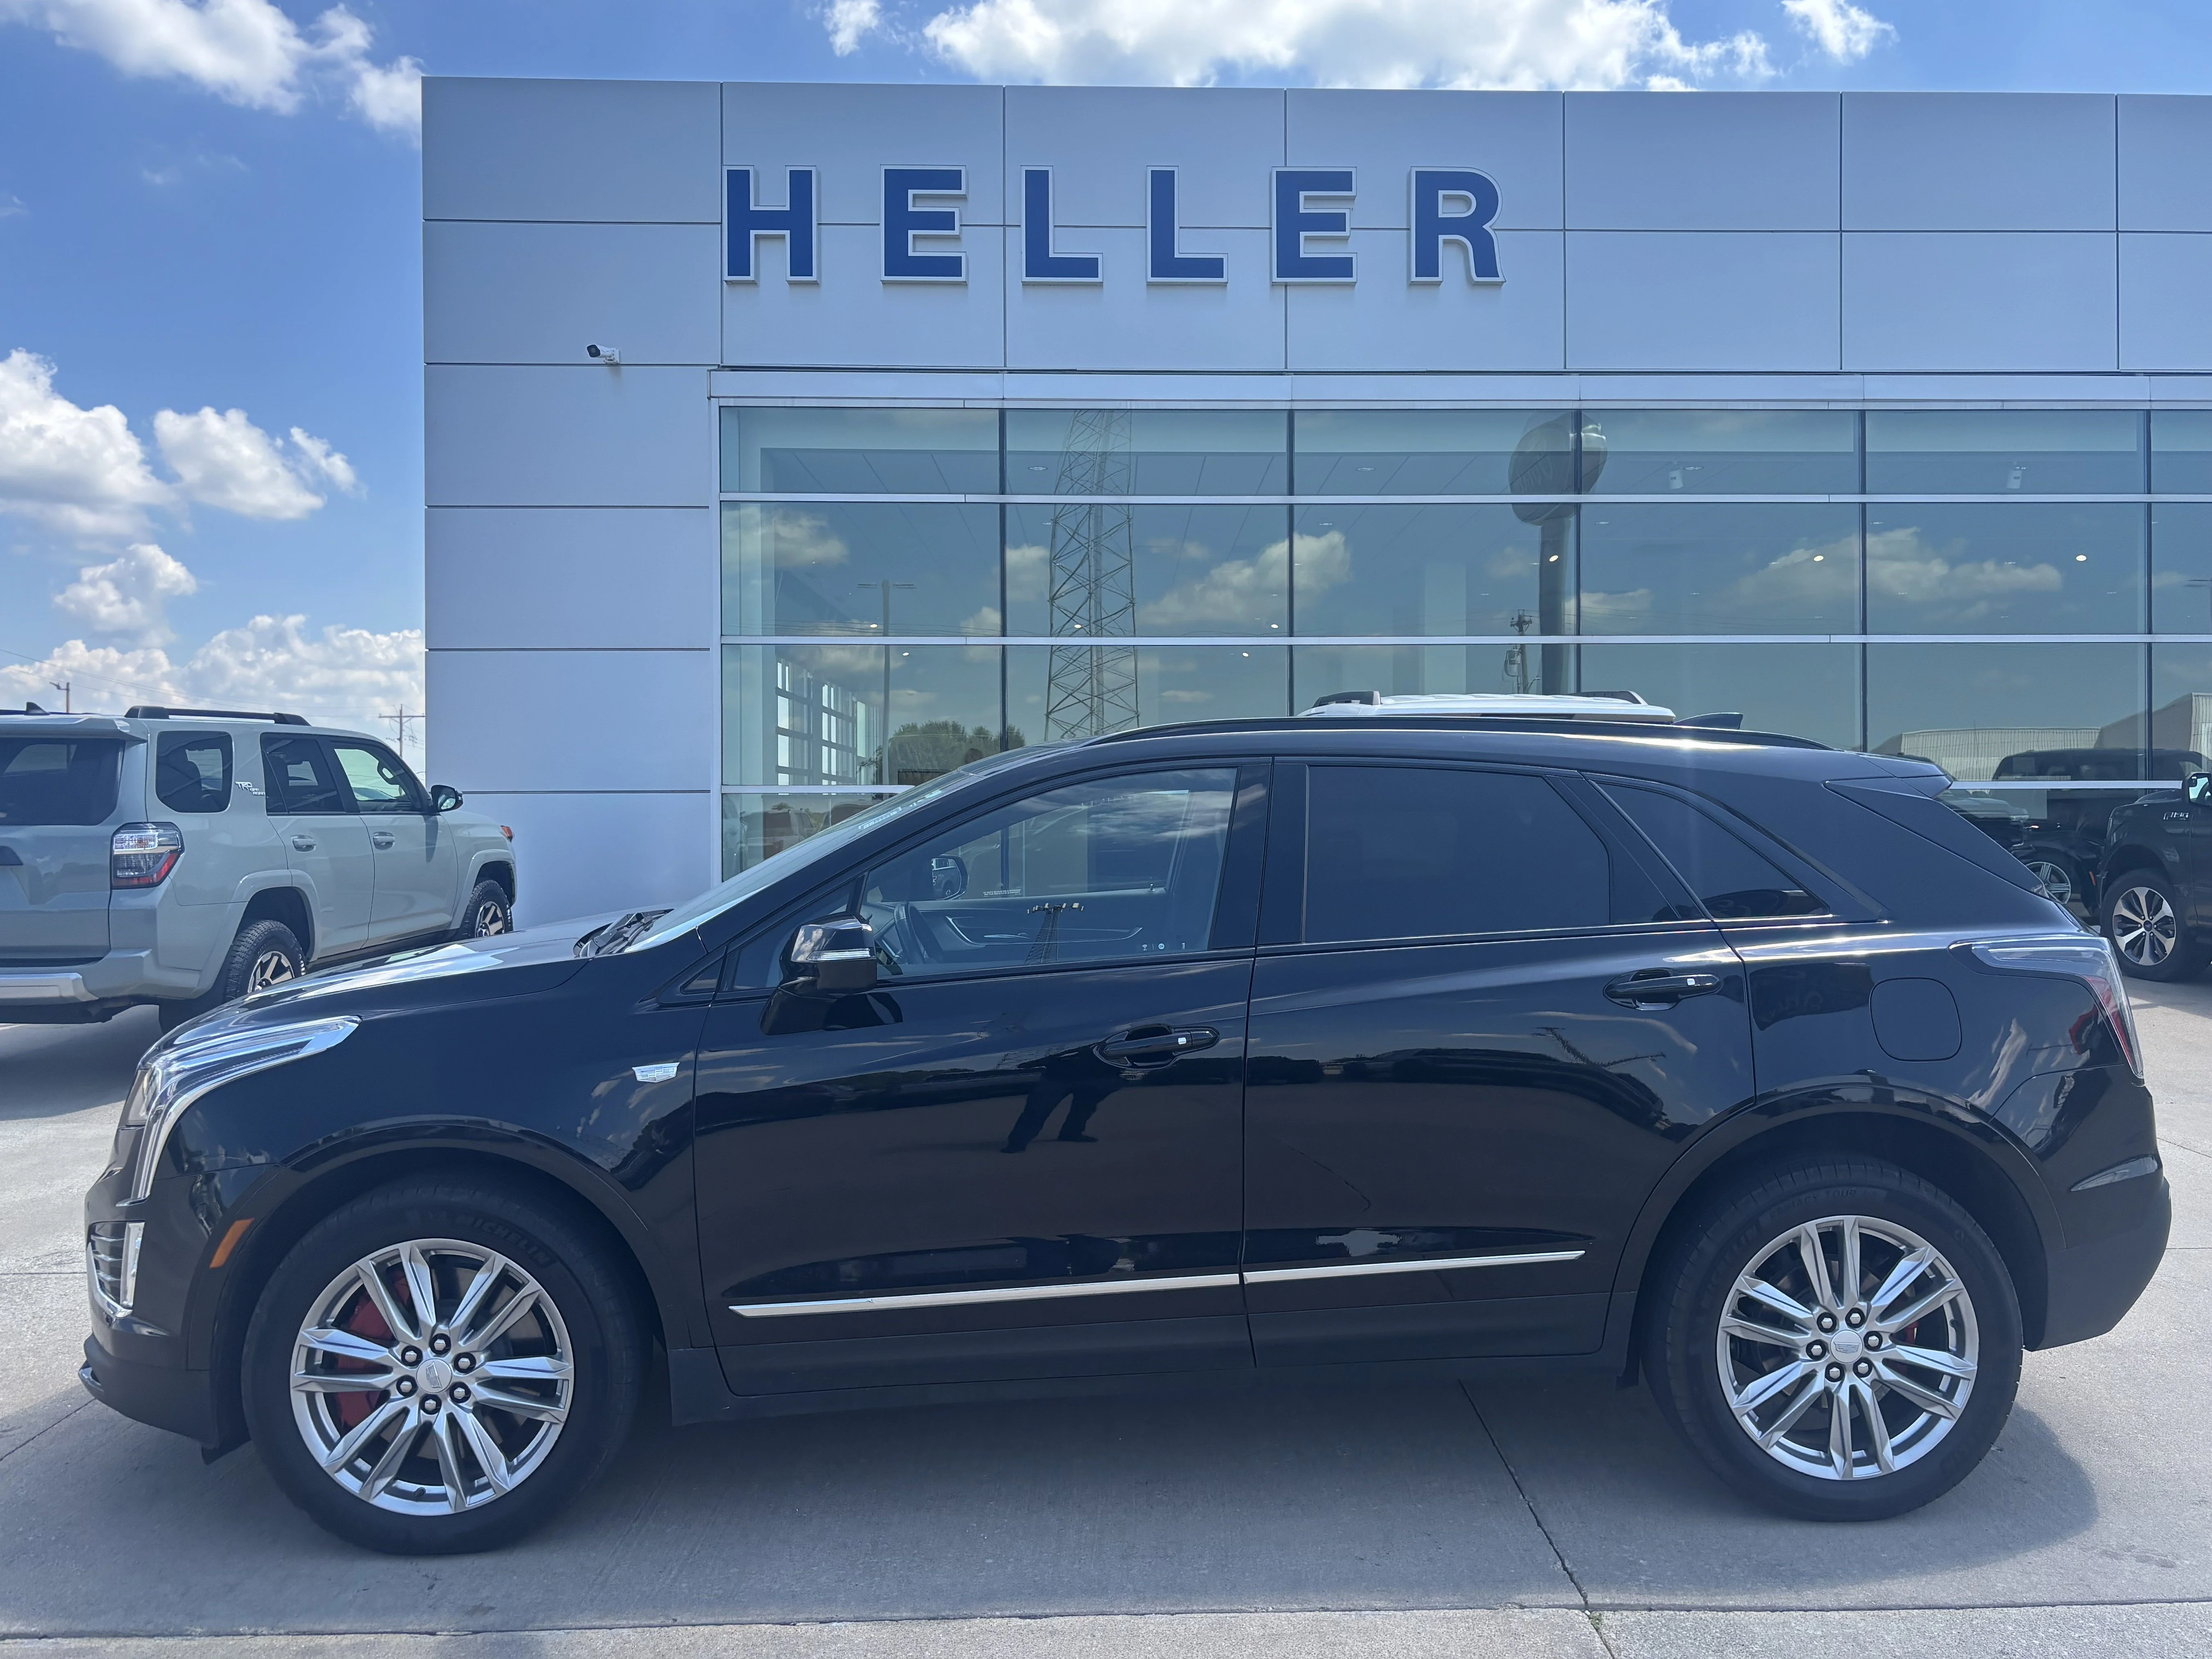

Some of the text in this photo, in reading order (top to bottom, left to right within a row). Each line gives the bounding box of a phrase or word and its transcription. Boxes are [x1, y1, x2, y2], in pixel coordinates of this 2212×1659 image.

[723, 165, 1505, 284] HELLER
[235, 781, 253, 791] TRD
[455, 1214, 551, 1265] MICHELIN
